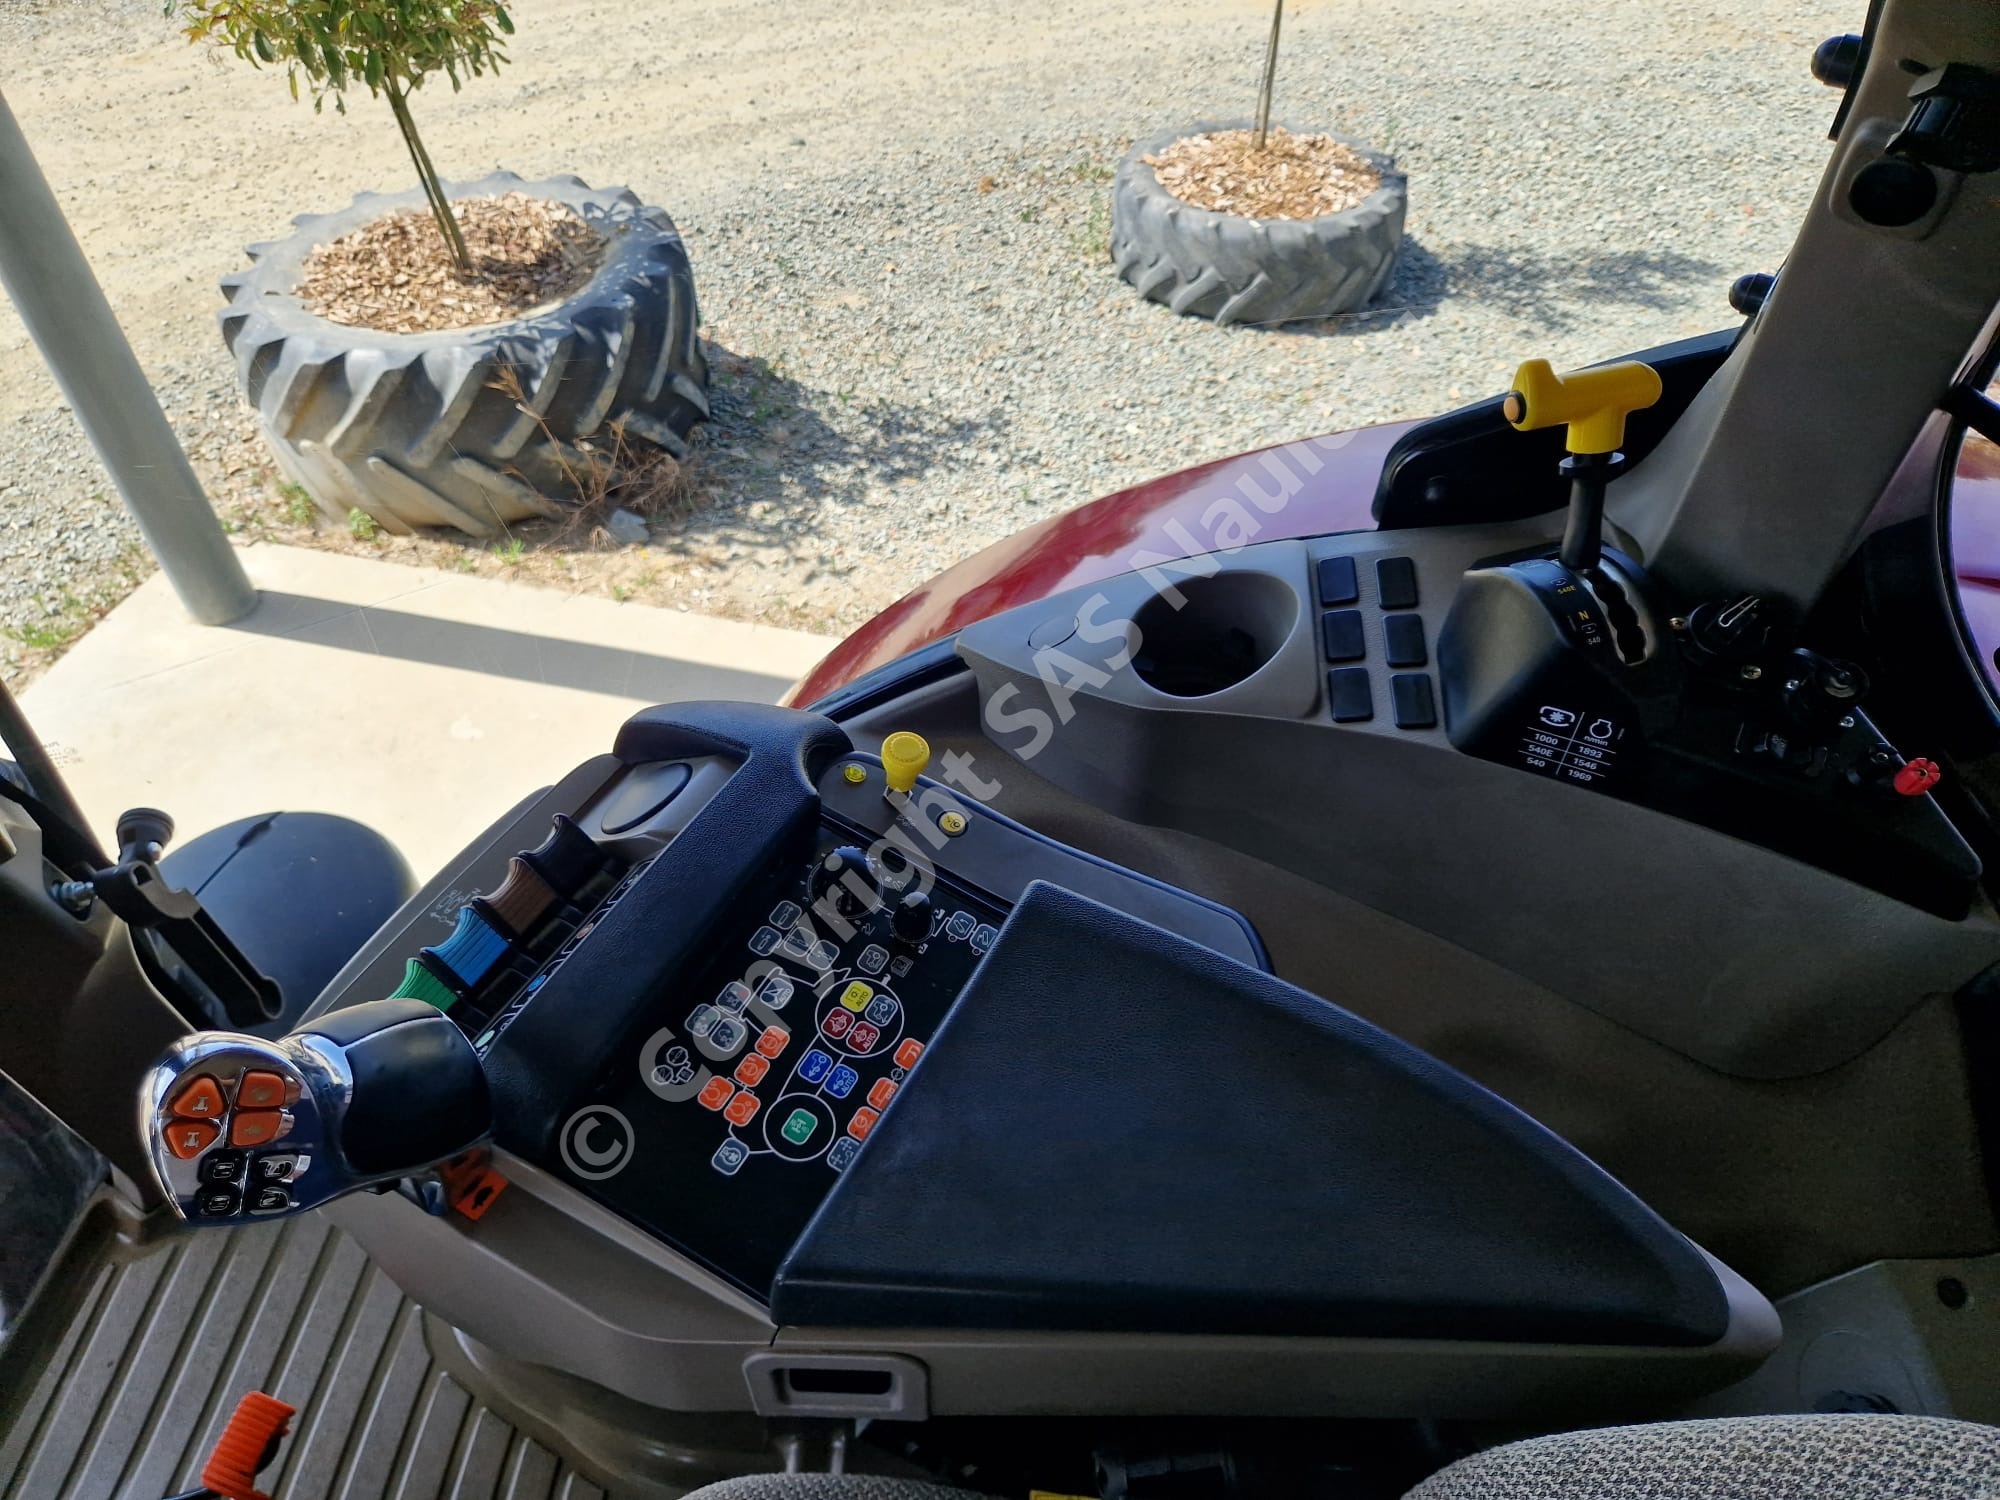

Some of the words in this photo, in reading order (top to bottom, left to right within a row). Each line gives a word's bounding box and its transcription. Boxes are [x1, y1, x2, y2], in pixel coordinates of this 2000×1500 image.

[1577, 609, 1590, 621] N
[1534, 733, 1558, 745] 1000
[1579, 746, 1603, 758] 1893
[1528, 744, 1554, 757] 540E
[1573, 758, 1597, 770] 1546
[1526, 757, 1546, 768] 540
[1567, 769, 1592, 781] 1969
[855, 990, 870, 1007] AUTO
[862, 1032, 876, 1050] AUTO
[841, 1075, 855, 1094] AUTO
